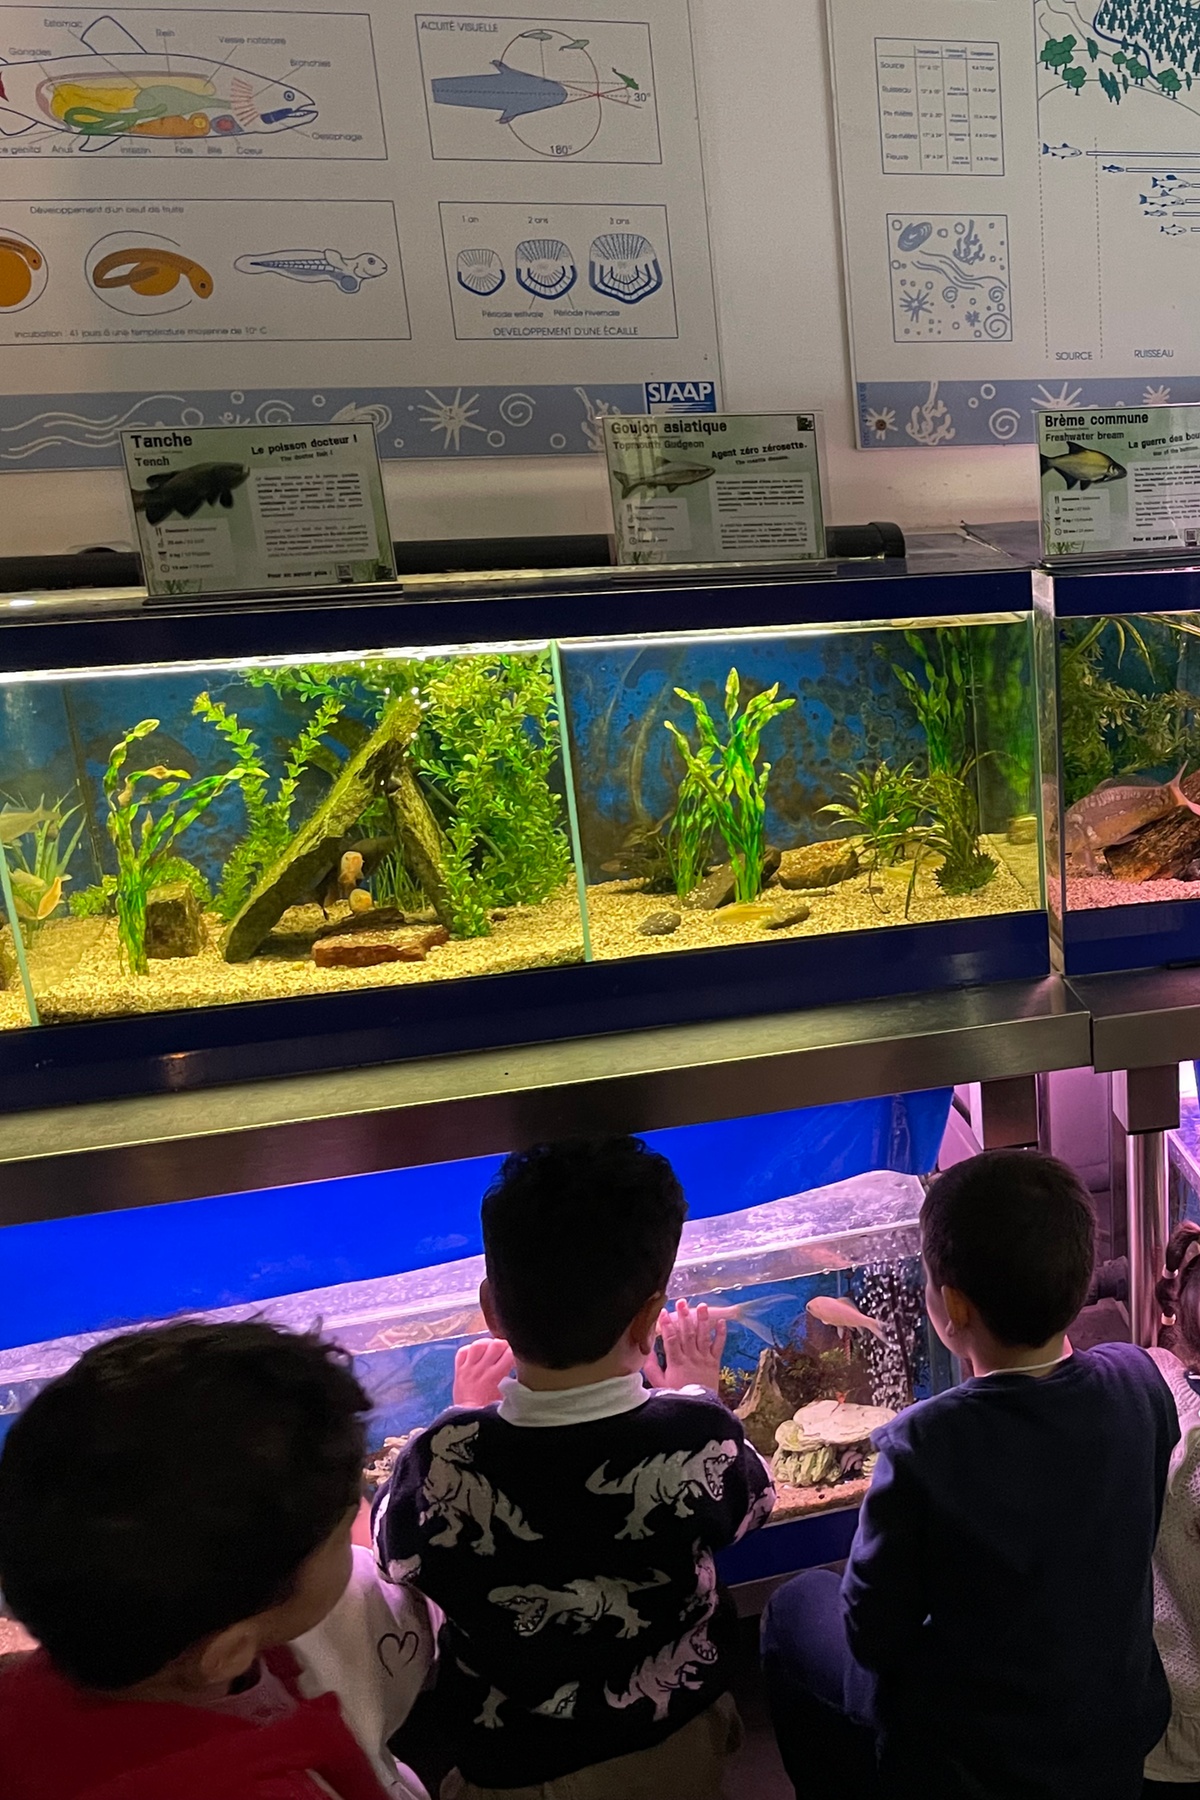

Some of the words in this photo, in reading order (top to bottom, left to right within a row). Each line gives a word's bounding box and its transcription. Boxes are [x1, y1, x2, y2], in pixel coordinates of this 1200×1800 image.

[458, 22, 498, 32] VISUELLE
[634, 93, 651, 102] 30°
[550, 145, 573, 155] 180°
[574, 327, 601, 336] D'UNE
[603, 326, 638, 336] ÉCAILLE
[1056, 352, 1093, 361] SOURCE
[1134, 349, 1174, 358] RUISSEAU
[648, 383, 712, 402] SIAAP
[1045, 414, 1084, 428] Brème
[1090, 413, 1149, 426] commune
[612, 421, 658, 437] Goujon
[664, 420, 728, 437] asiatique
[131, 433, 192, 449] Tanche
[1045, 432, 1095, 442] Freshwater
[1097, 430, 1124, 440] bream
[251, 446, 264, 456] Le
[268, 441, 308, 455] poisson
[311, 436, 349, 448] docteur
[613, 440, 662, 451] Topmouth
[664, 440, 704, 450] Gudgeon
[1128, 441, 1138, 450] La
[1141, 437, 1166, 450] guerre
[1170, 434, 1184, 444] des
[711, 448, 737, 460] Agent
[740, 445, 760, 456] zéro
[762, 441, 808, 454] zérosette.
[134, 456, 170, 467] Tench
